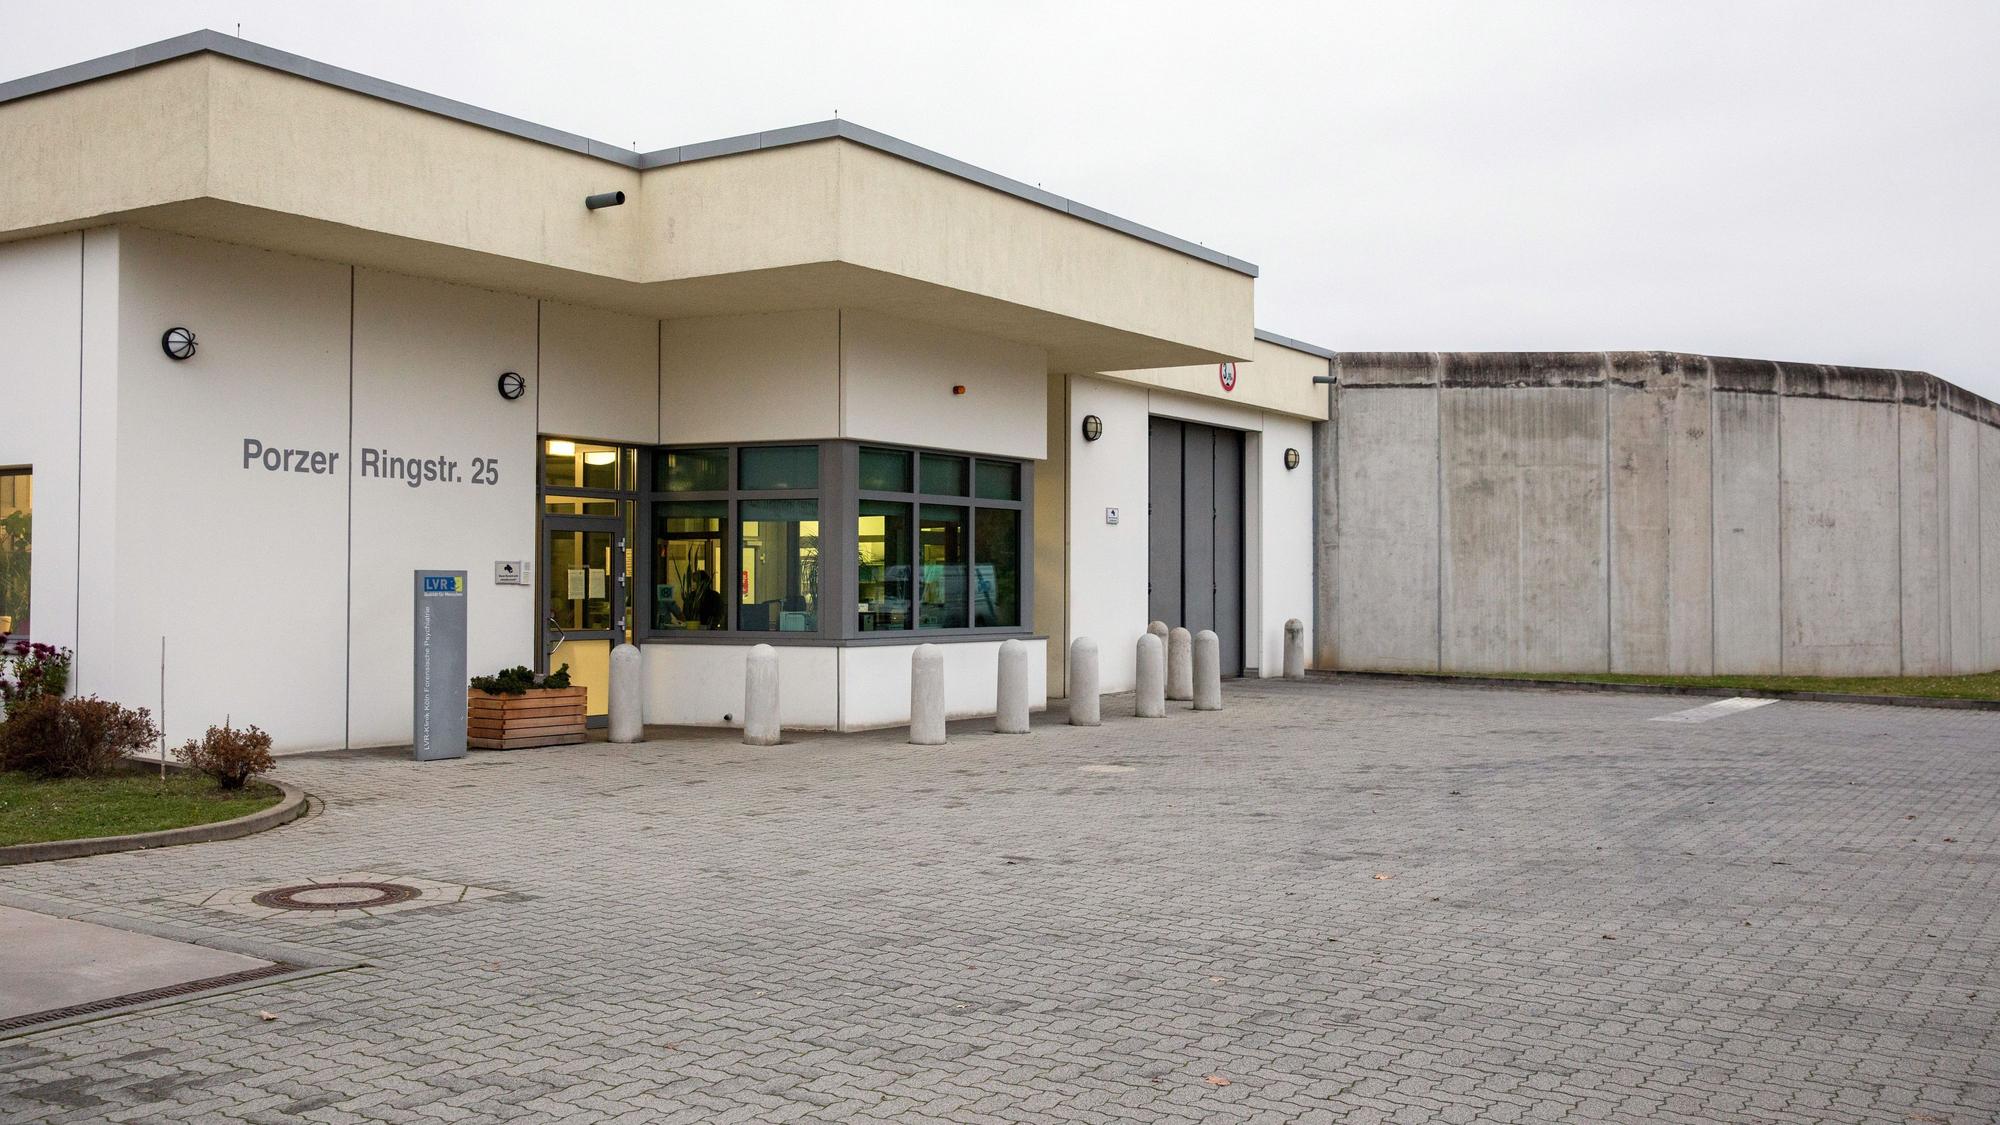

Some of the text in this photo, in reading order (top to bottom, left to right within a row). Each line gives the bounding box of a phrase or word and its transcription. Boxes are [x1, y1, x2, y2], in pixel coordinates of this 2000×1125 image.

[243, 438, 499, 488] Porzer Ringstr. 25
[426, 578, 448, 590] LVR
